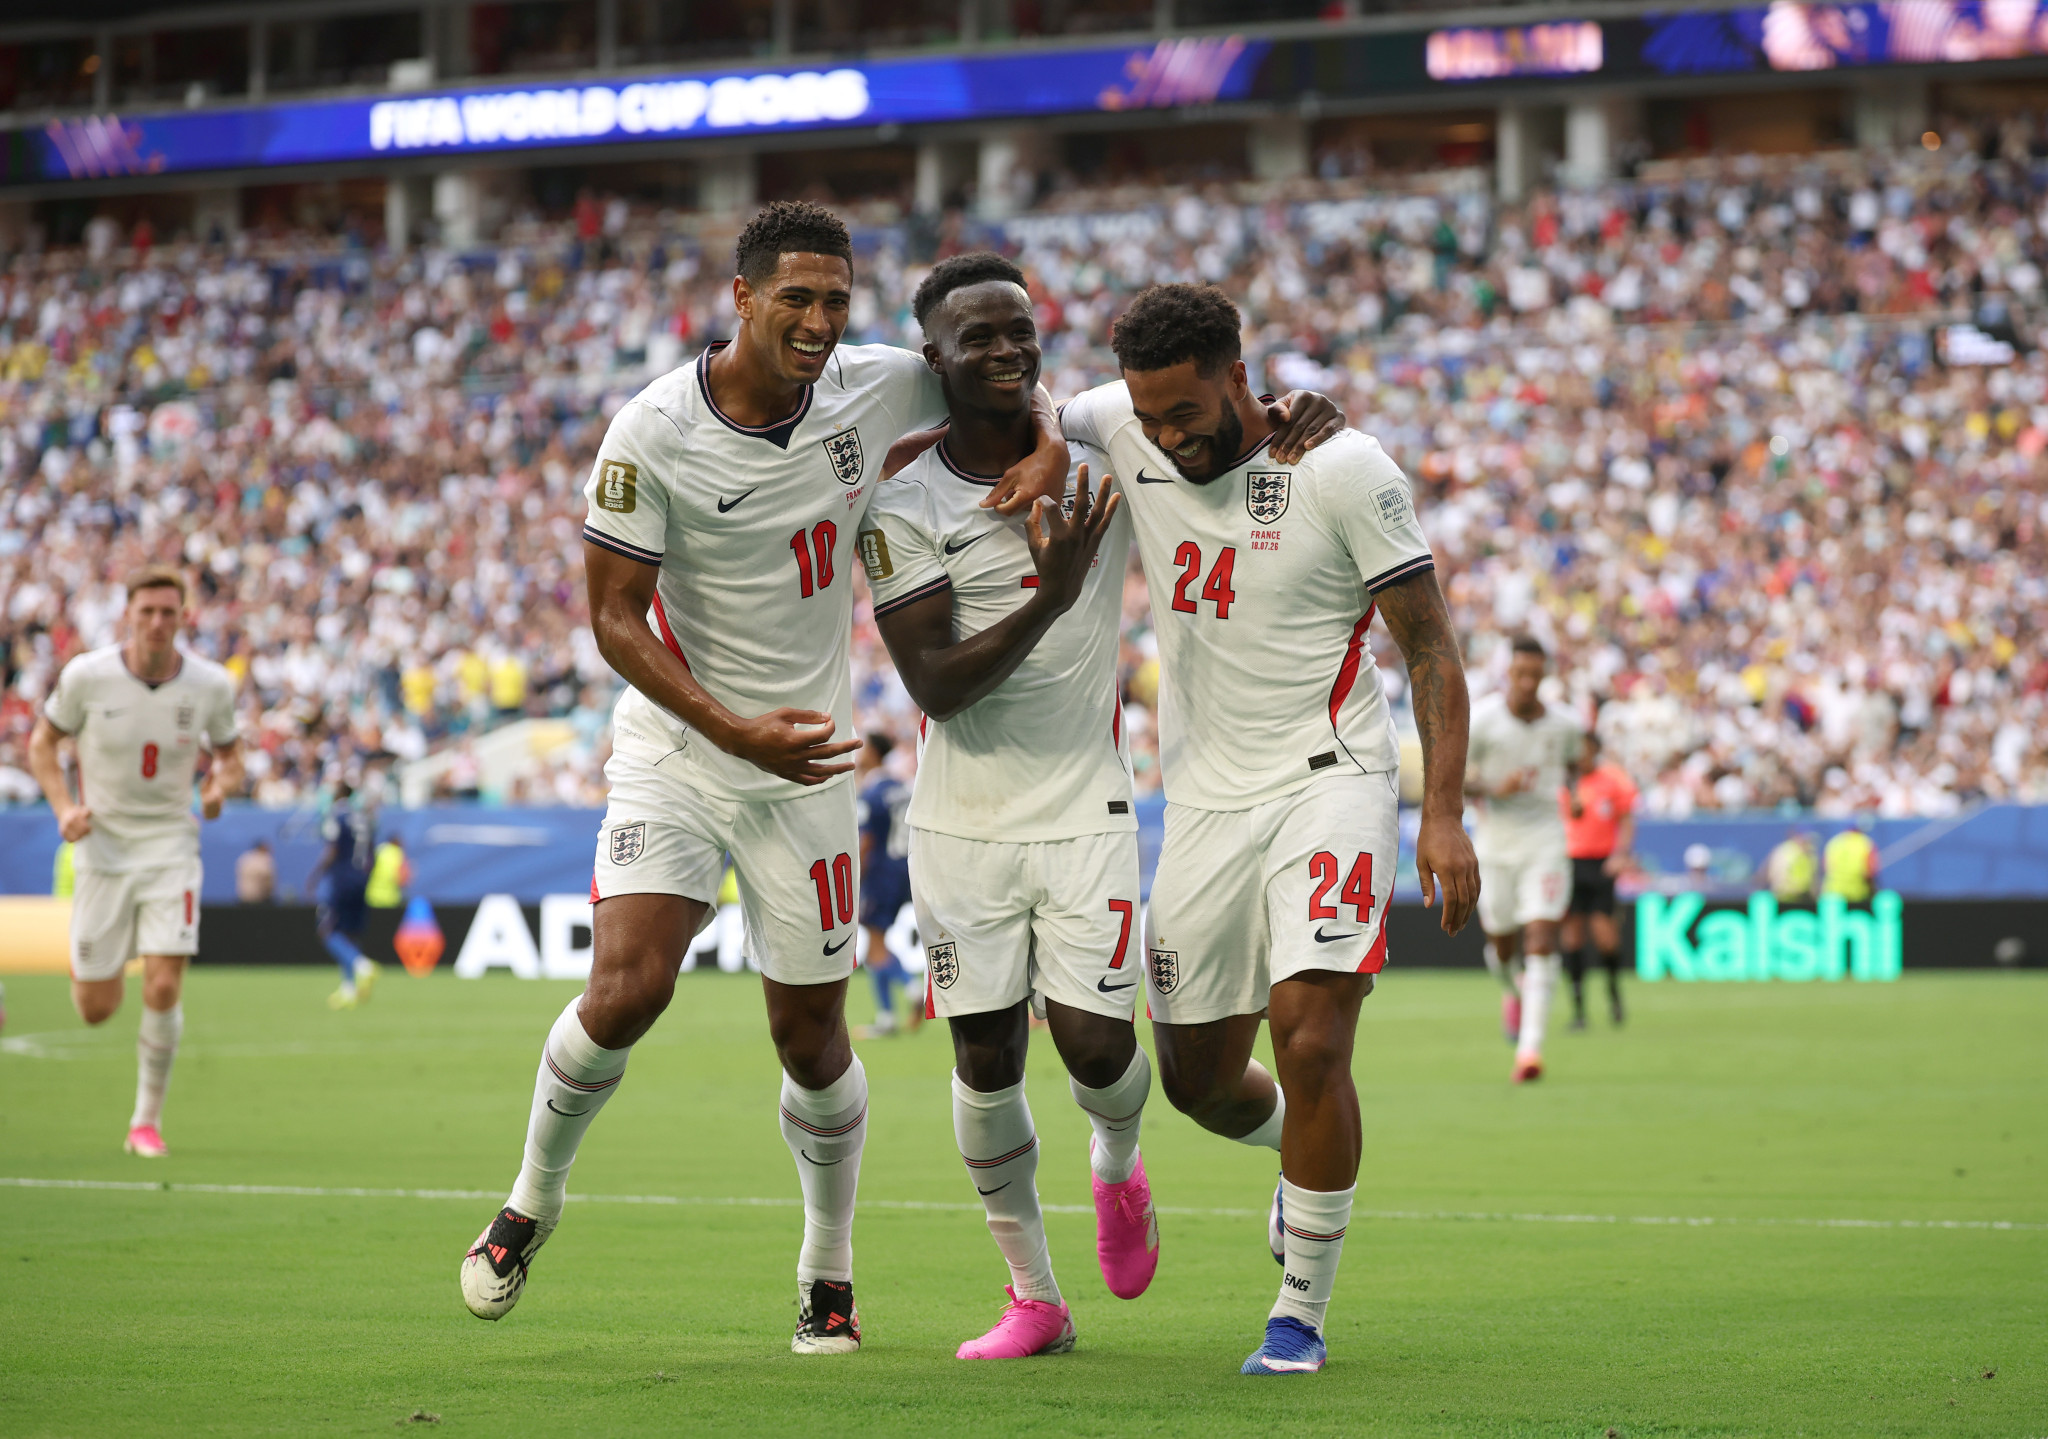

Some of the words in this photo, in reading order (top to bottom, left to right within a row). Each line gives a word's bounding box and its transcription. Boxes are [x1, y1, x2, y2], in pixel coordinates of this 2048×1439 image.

[370, 97, 464, 151] FIFA
[463, 86, 618, 143] WORLD
[618, 79, 708, 133] CUP
[707, 69, 869, 127] 2026
[846, 485, 866, 501] FRAN
[1376, 486, 1400, 501] FOOTBALL
[1380, 492, 1403, 510] UNITES
[789, 519, 837, 599] 10
[1250, 530, 1280, 540] FRANCE
[1251, 542, 1278, 550] 18.07.26
[1171, 540, 1237, 620] 24
[141, 742, 159, 779] 8
[808, 851, 854, 932] 10
[1308, 850, 1376, 925] 24
[1107, 898, 1133, 970] 7
[1635, 889, 1904, 982] Kalshi
[1284, 1272, 1311, 1292] ENG
